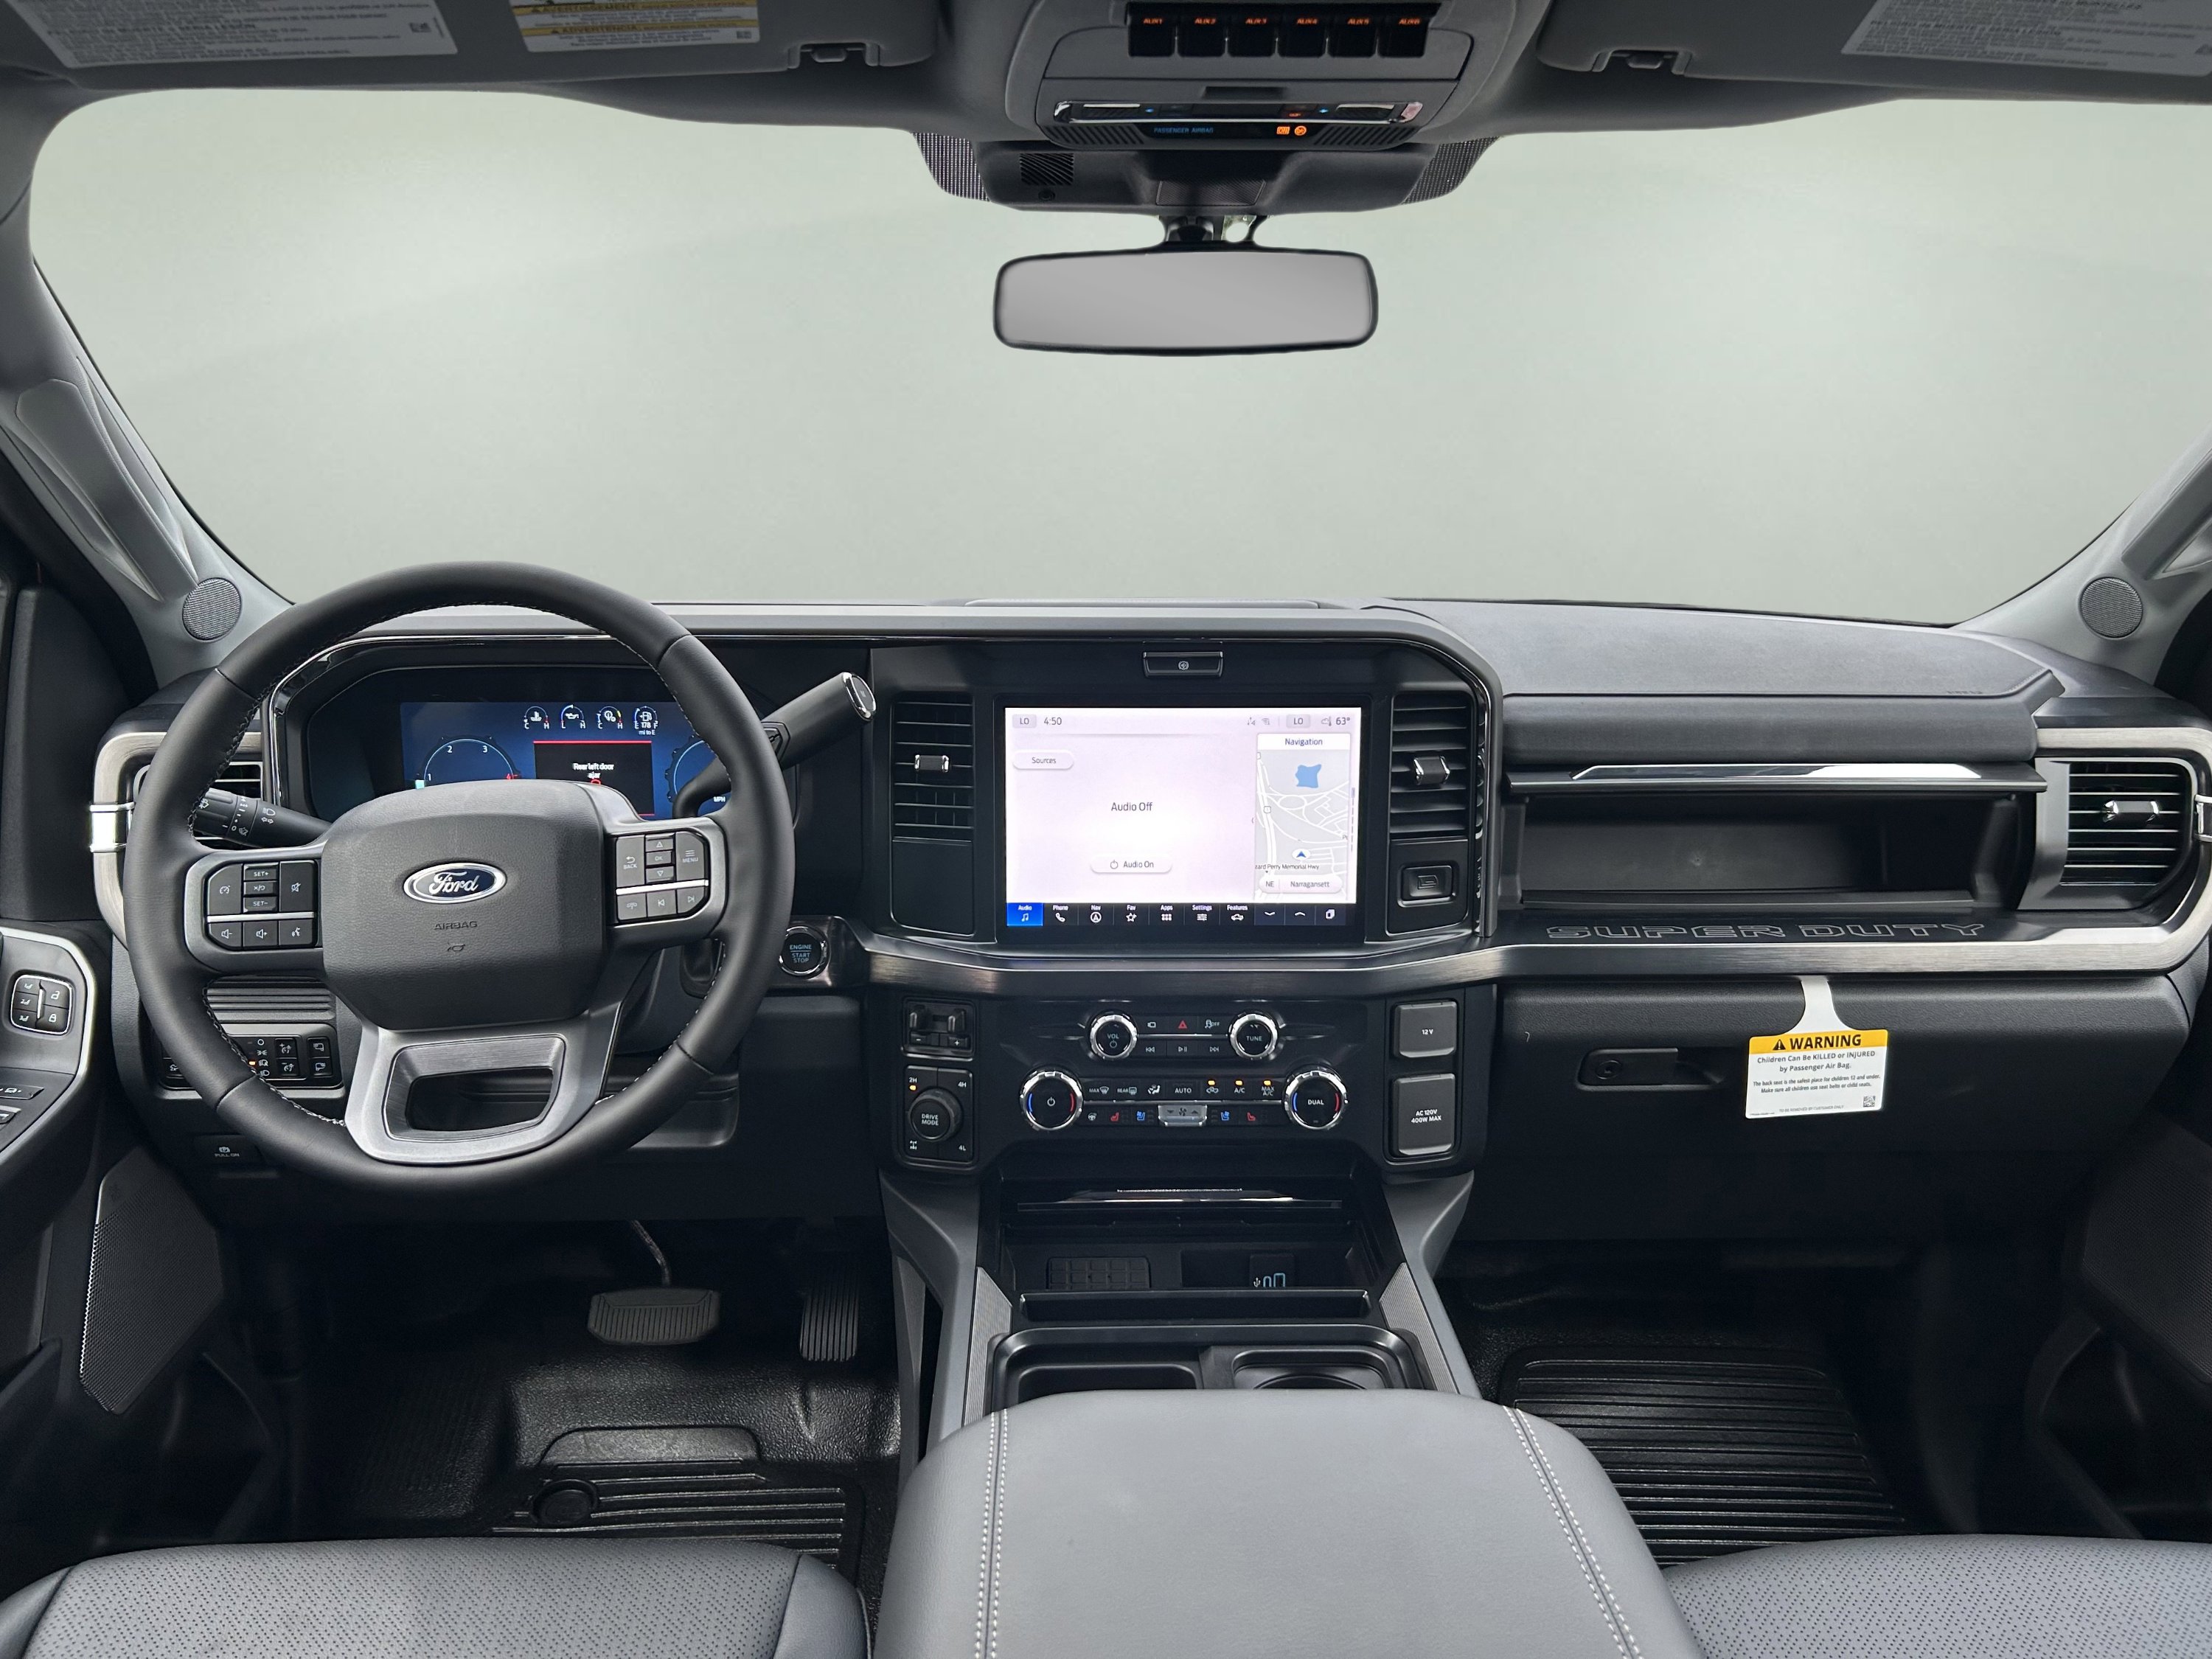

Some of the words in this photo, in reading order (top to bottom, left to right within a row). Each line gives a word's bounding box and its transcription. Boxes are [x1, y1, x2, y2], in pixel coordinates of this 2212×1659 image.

[1043, 717, 1062, 726] 4:50
[1284, 738, 1324, 747] Navigation
[1110, 802, 1137, 811] Audio
[1138, 802, 1153, 811] Off
[428, 871, 479, 894] Ford
[434, 921, 478, 930] AIRBAG
[1546, 925, 1786, 939] SUPER
[1798, 923, 1985, 937] DUTY
[1790, 1034, 1862, 1050] WARNING
[1846, 1051, 1876, 1059] INJURED
[1837, 1062, 1851, 1070] Bag.
